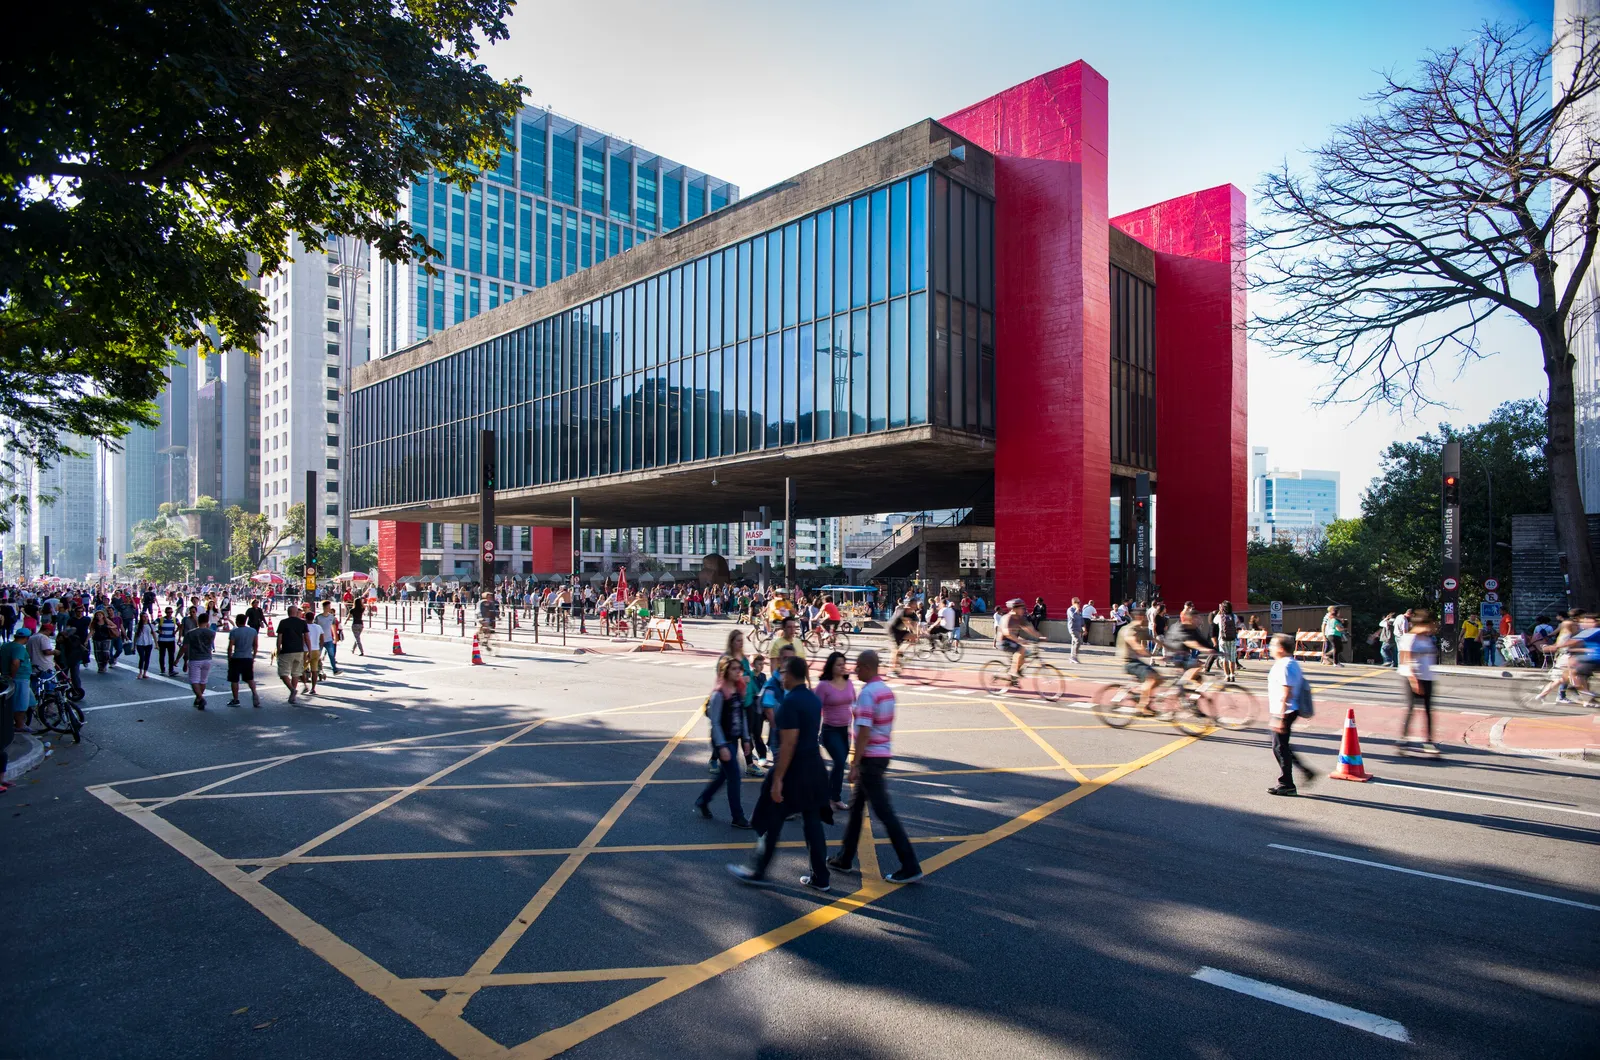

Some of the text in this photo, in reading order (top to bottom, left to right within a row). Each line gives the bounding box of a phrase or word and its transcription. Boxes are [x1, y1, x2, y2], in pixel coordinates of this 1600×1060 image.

[745, 531, 764, 539] MASP
[1444, 508, 1453, 560] Av. Paulista
